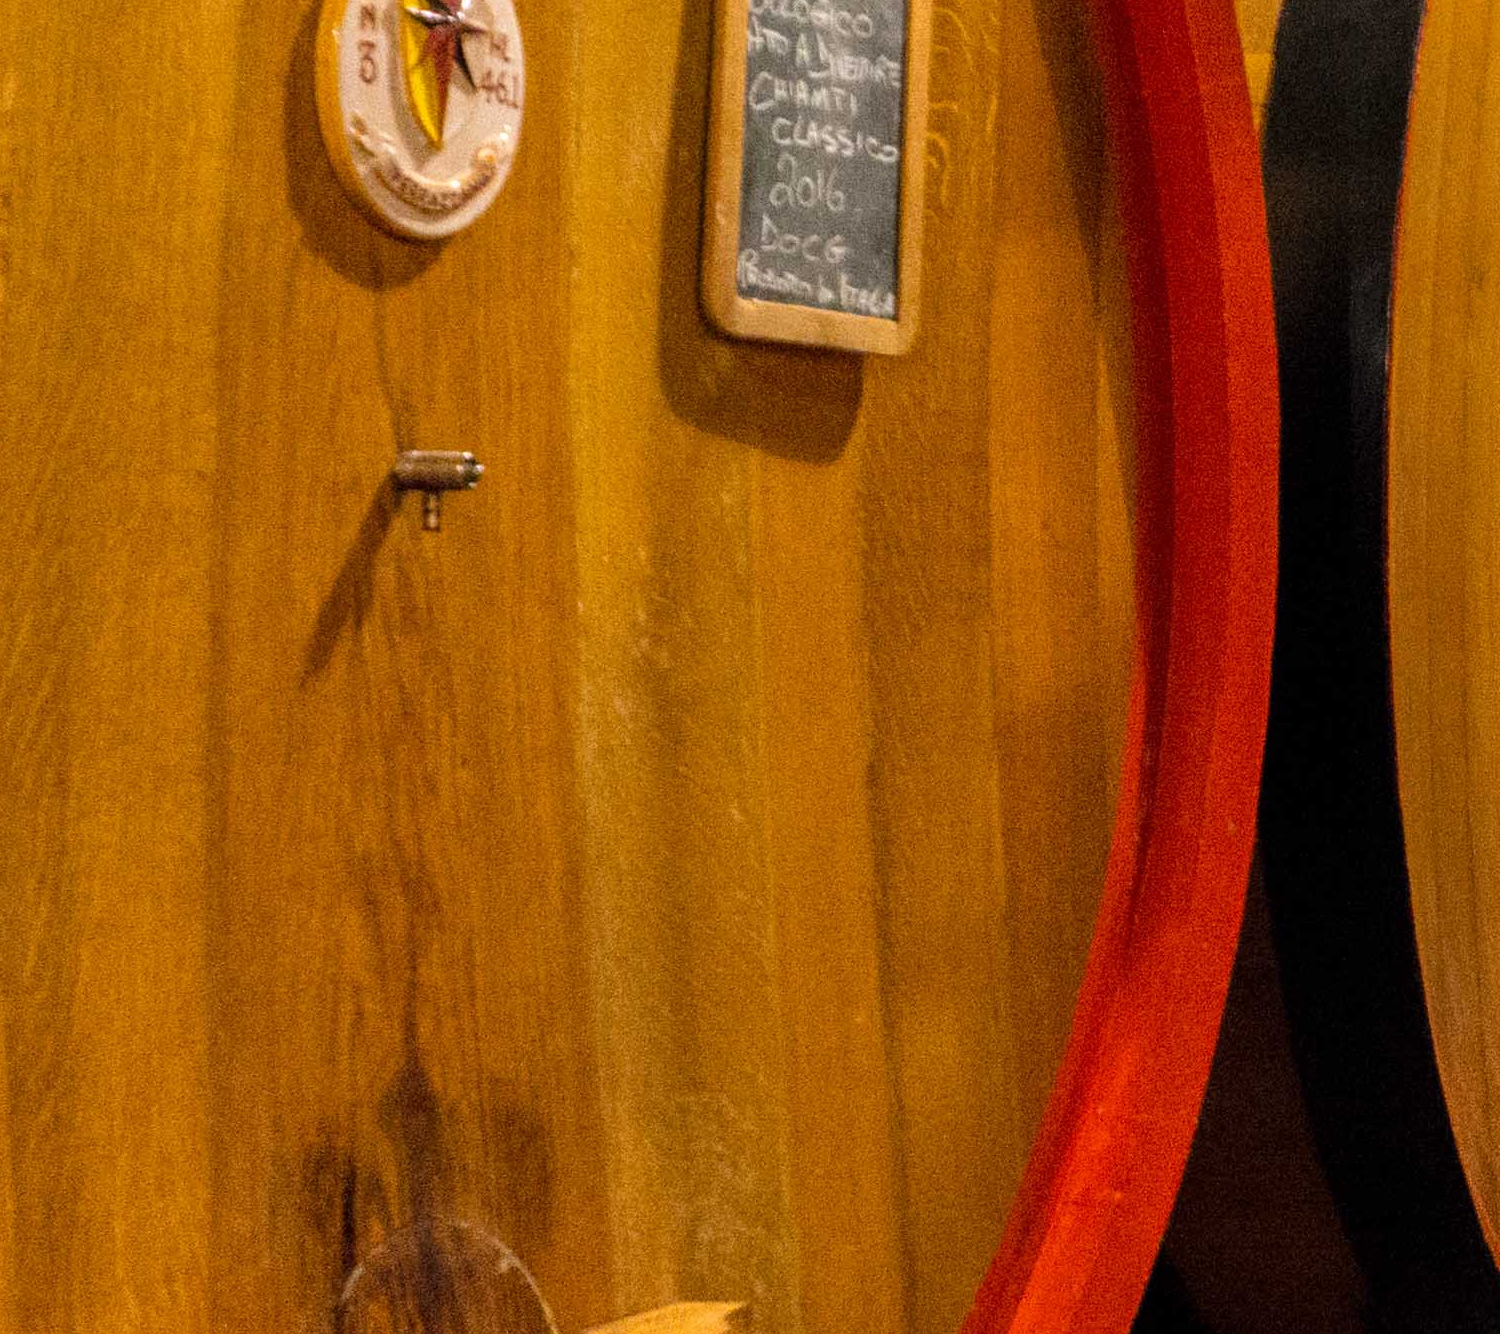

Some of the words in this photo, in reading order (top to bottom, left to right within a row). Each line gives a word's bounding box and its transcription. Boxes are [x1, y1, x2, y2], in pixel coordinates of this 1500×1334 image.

[749, 70, 858, 118] CHIANTI
[771, 115, 898, 163] CLASSICO
[769, 153, 847, 212] 2016
